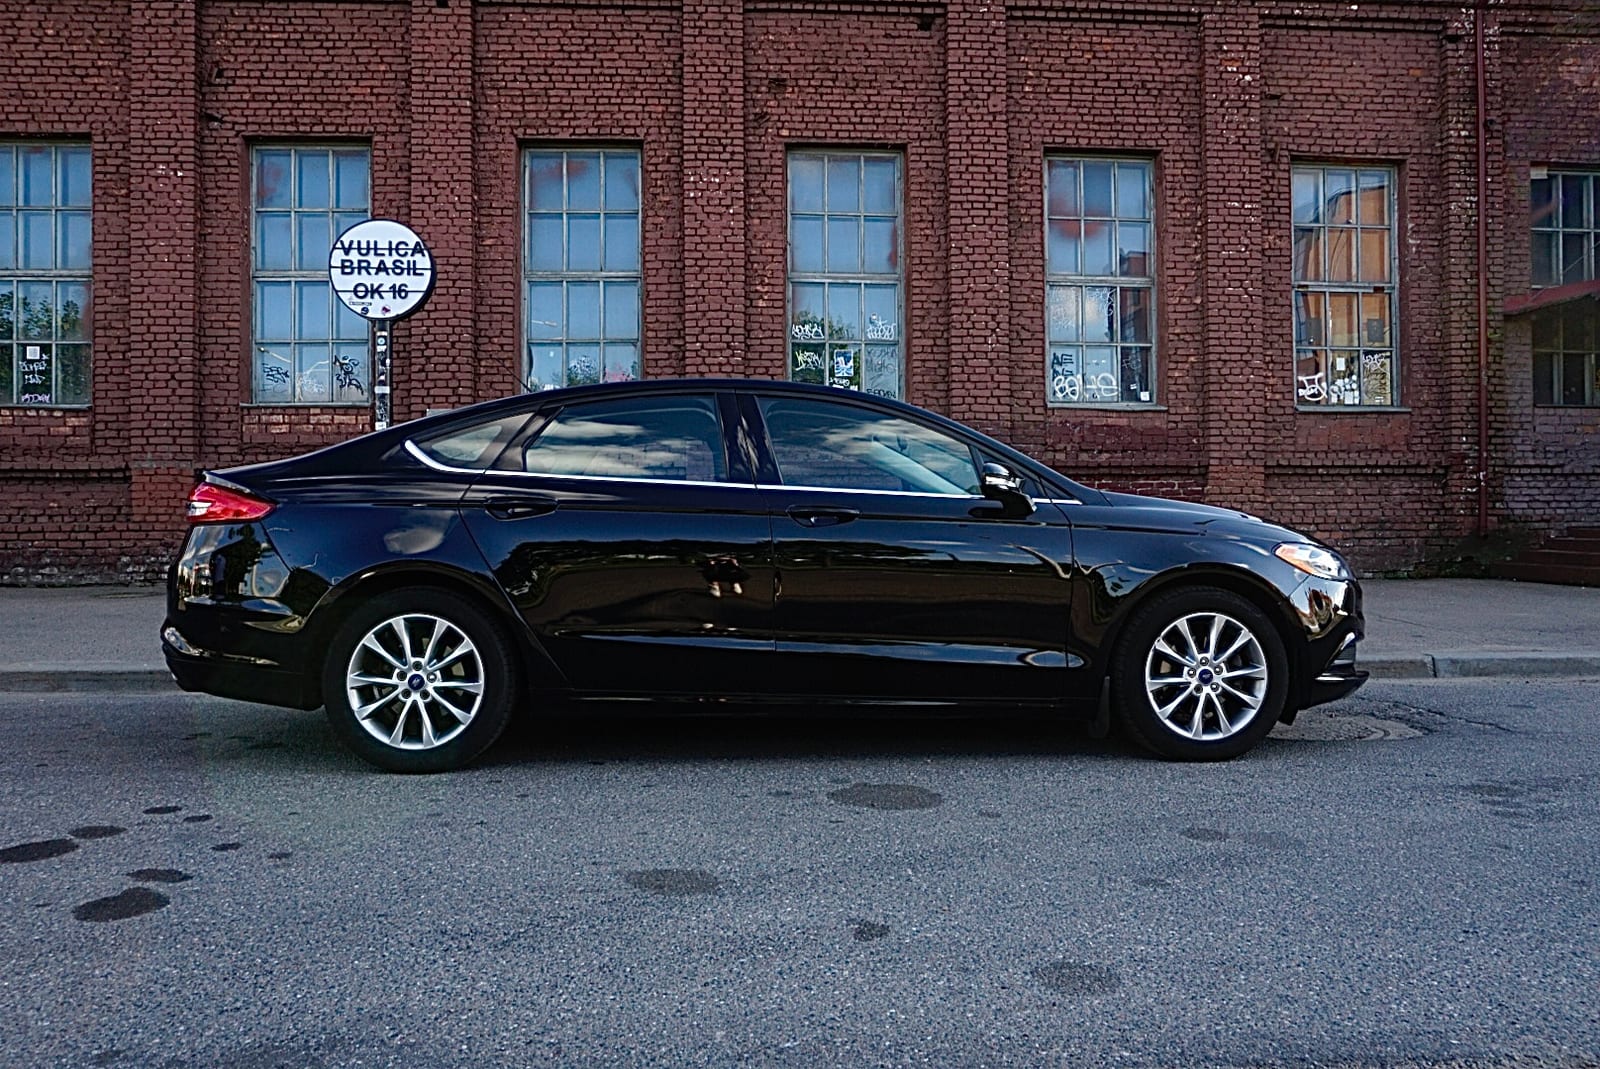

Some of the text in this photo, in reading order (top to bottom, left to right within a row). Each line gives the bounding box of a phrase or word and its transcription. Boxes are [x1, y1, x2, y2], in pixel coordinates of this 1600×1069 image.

[340, 240, 425, 257] VULICA
[340, 259, 424, 276] BRASIL
[353, 282, 408, 300] OK 16
